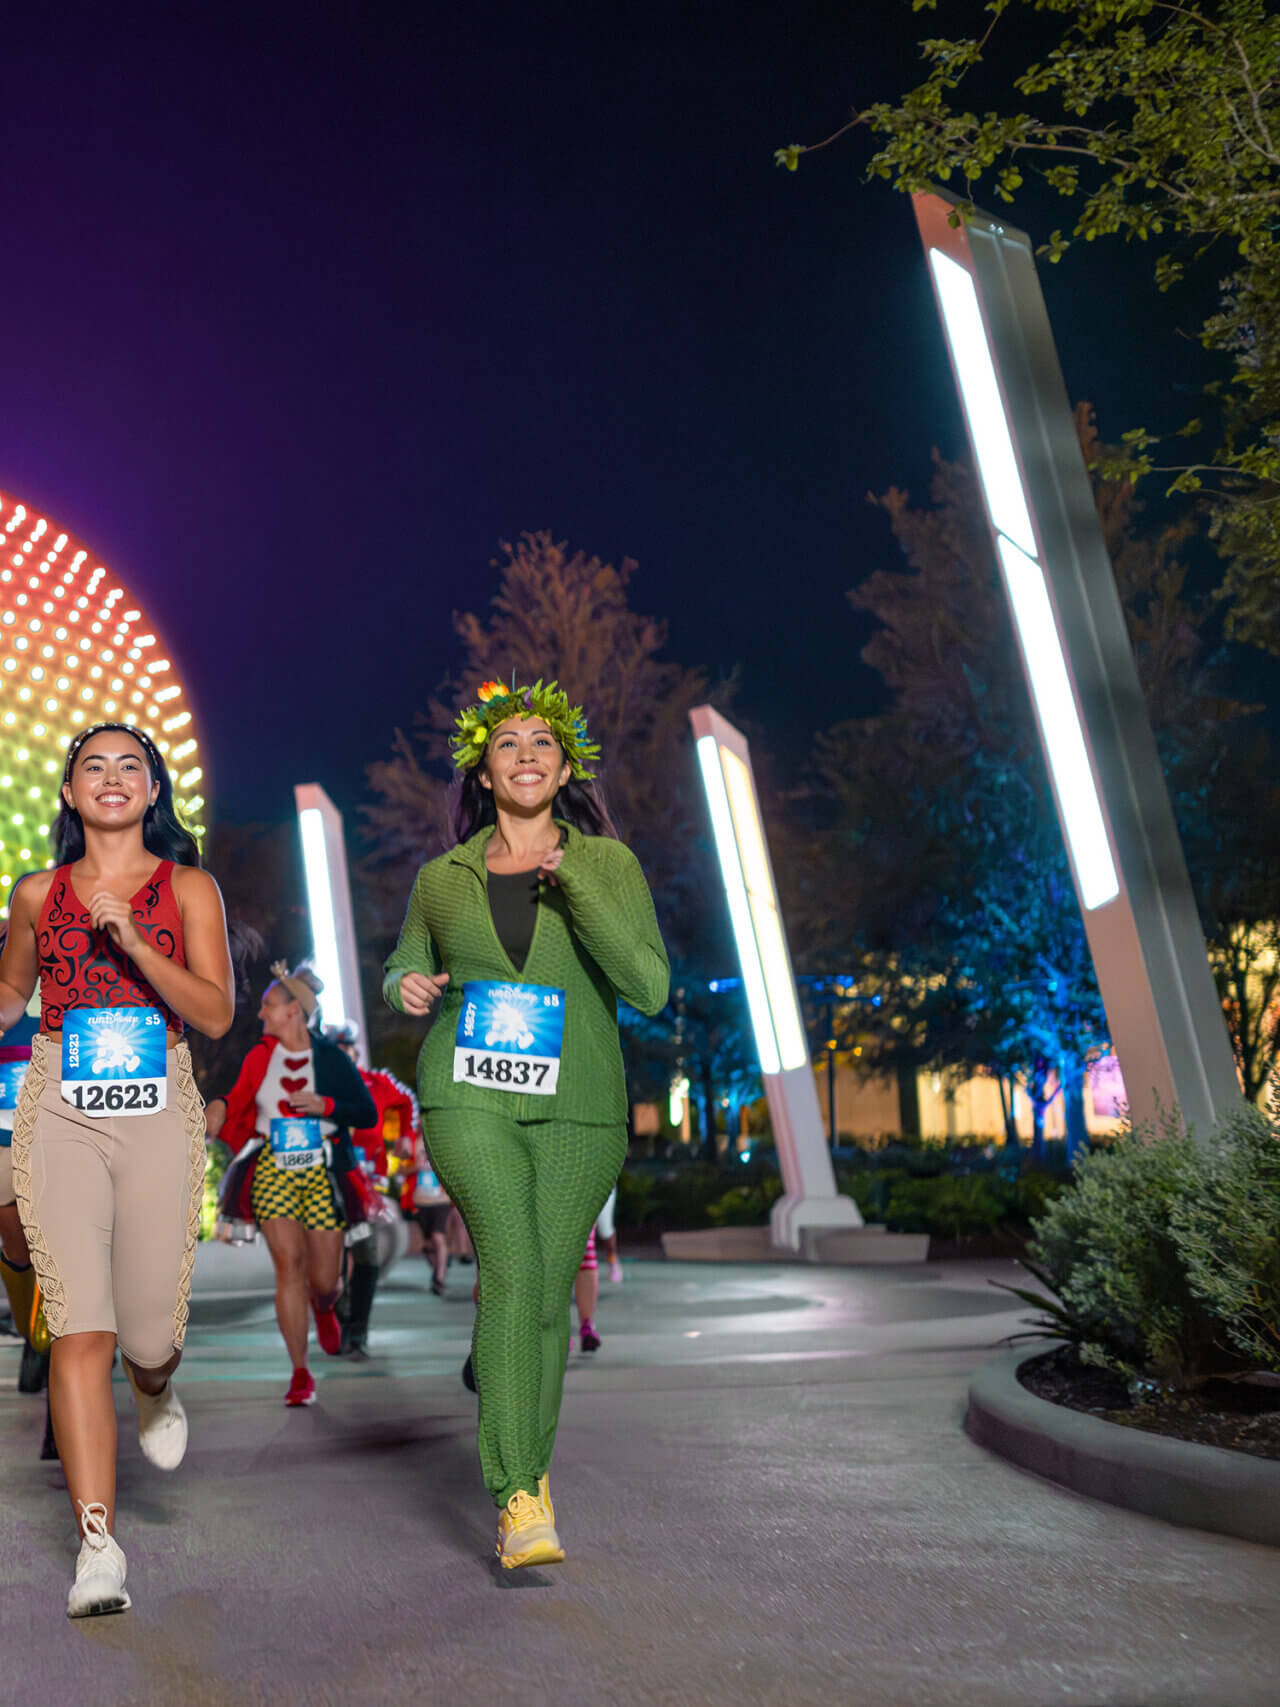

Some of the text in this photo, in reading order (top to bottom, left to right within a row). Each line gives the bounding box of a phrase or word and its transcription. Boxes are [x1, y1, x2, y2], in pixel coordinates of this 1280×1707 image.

[69, 1033, 80, 1068] 12623
[465, 1055, 550, 1087] 14837
[72, 1083, 159, 1110] 12623
